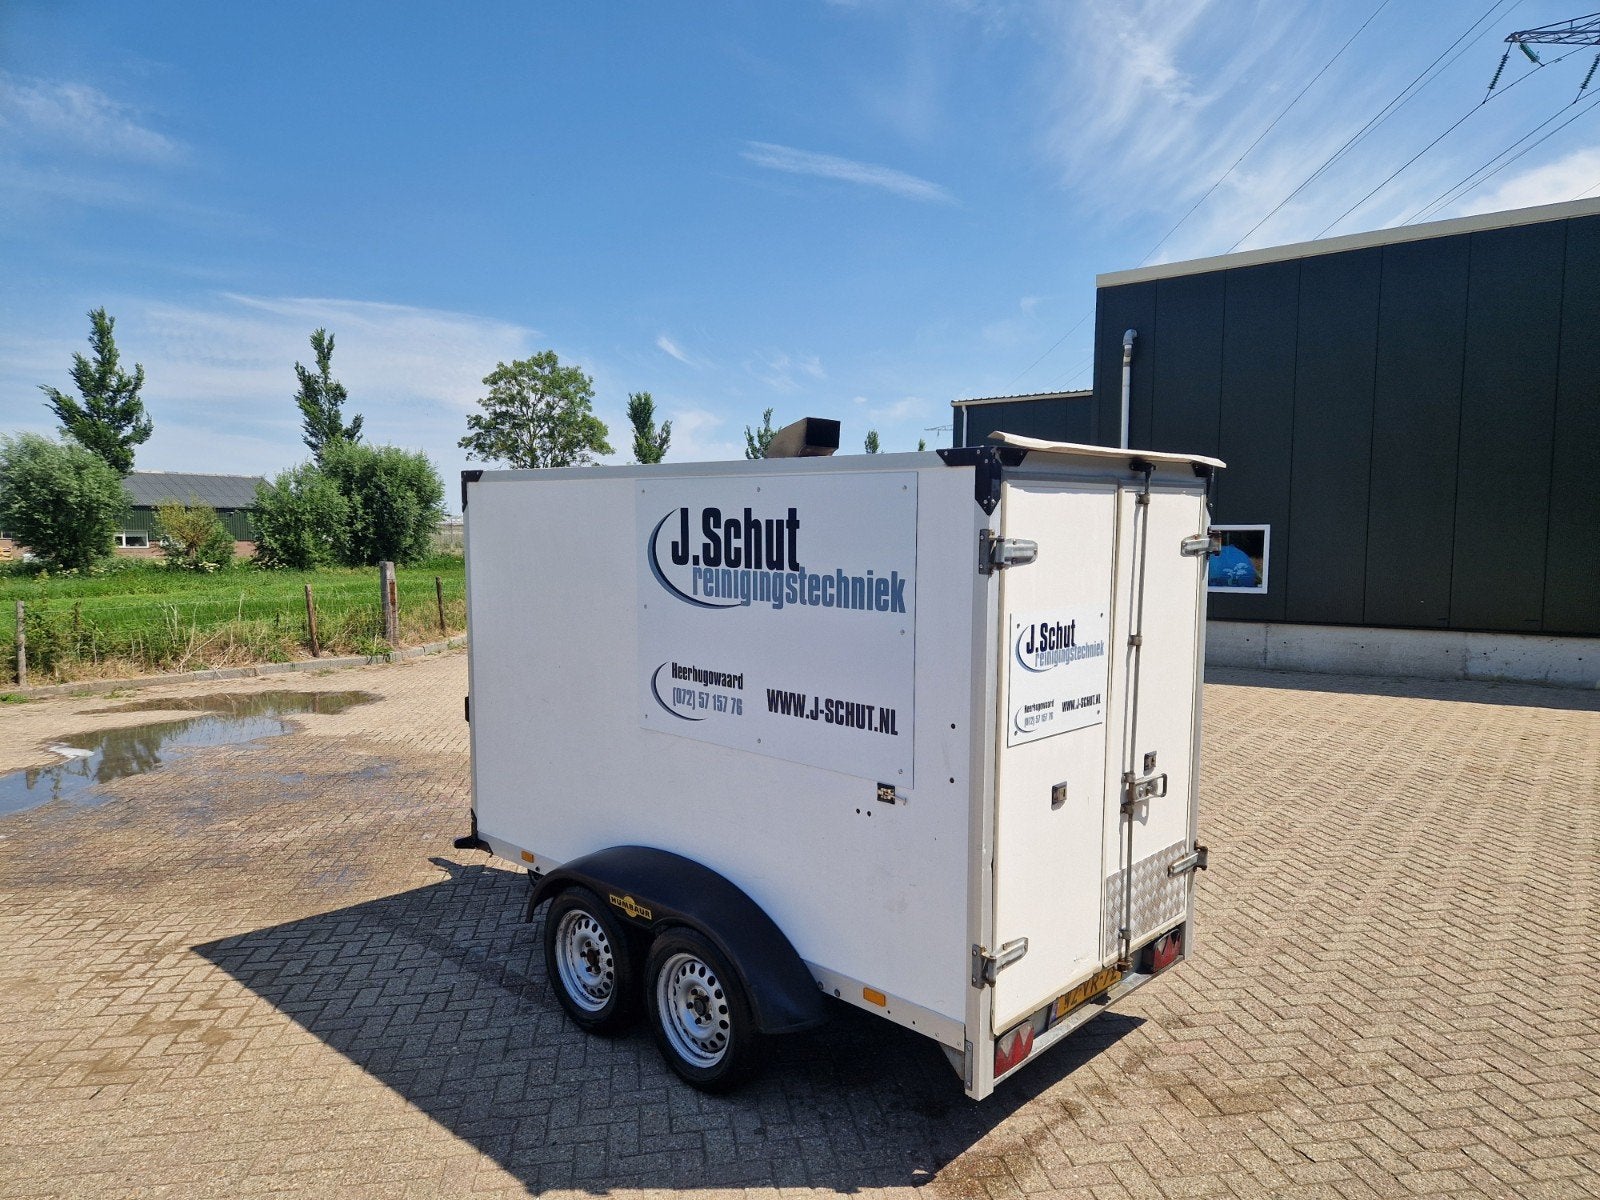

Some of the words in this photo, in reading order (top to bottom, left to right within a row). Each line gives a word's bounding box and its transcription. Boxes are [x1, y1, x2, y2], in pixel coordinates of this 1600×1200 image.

[671, 507, 800, 572] J.Schut
[692, 566, 906, 613] reinigingstechniek
[1026, 619, 1075, 654] J.Schut
[1035, 640, 1104, 667] reinigingstechniek
[672, 662, 743, 690] Heerhugowaard
[673, 687, 695, 710] (072)
[699, 692, 709, 709] 57
[712, 694, 727, 712] 157
[731, 697, 742, 715] 76
[766, 688, 898, 736] WWW.J-SCHUT.NL
